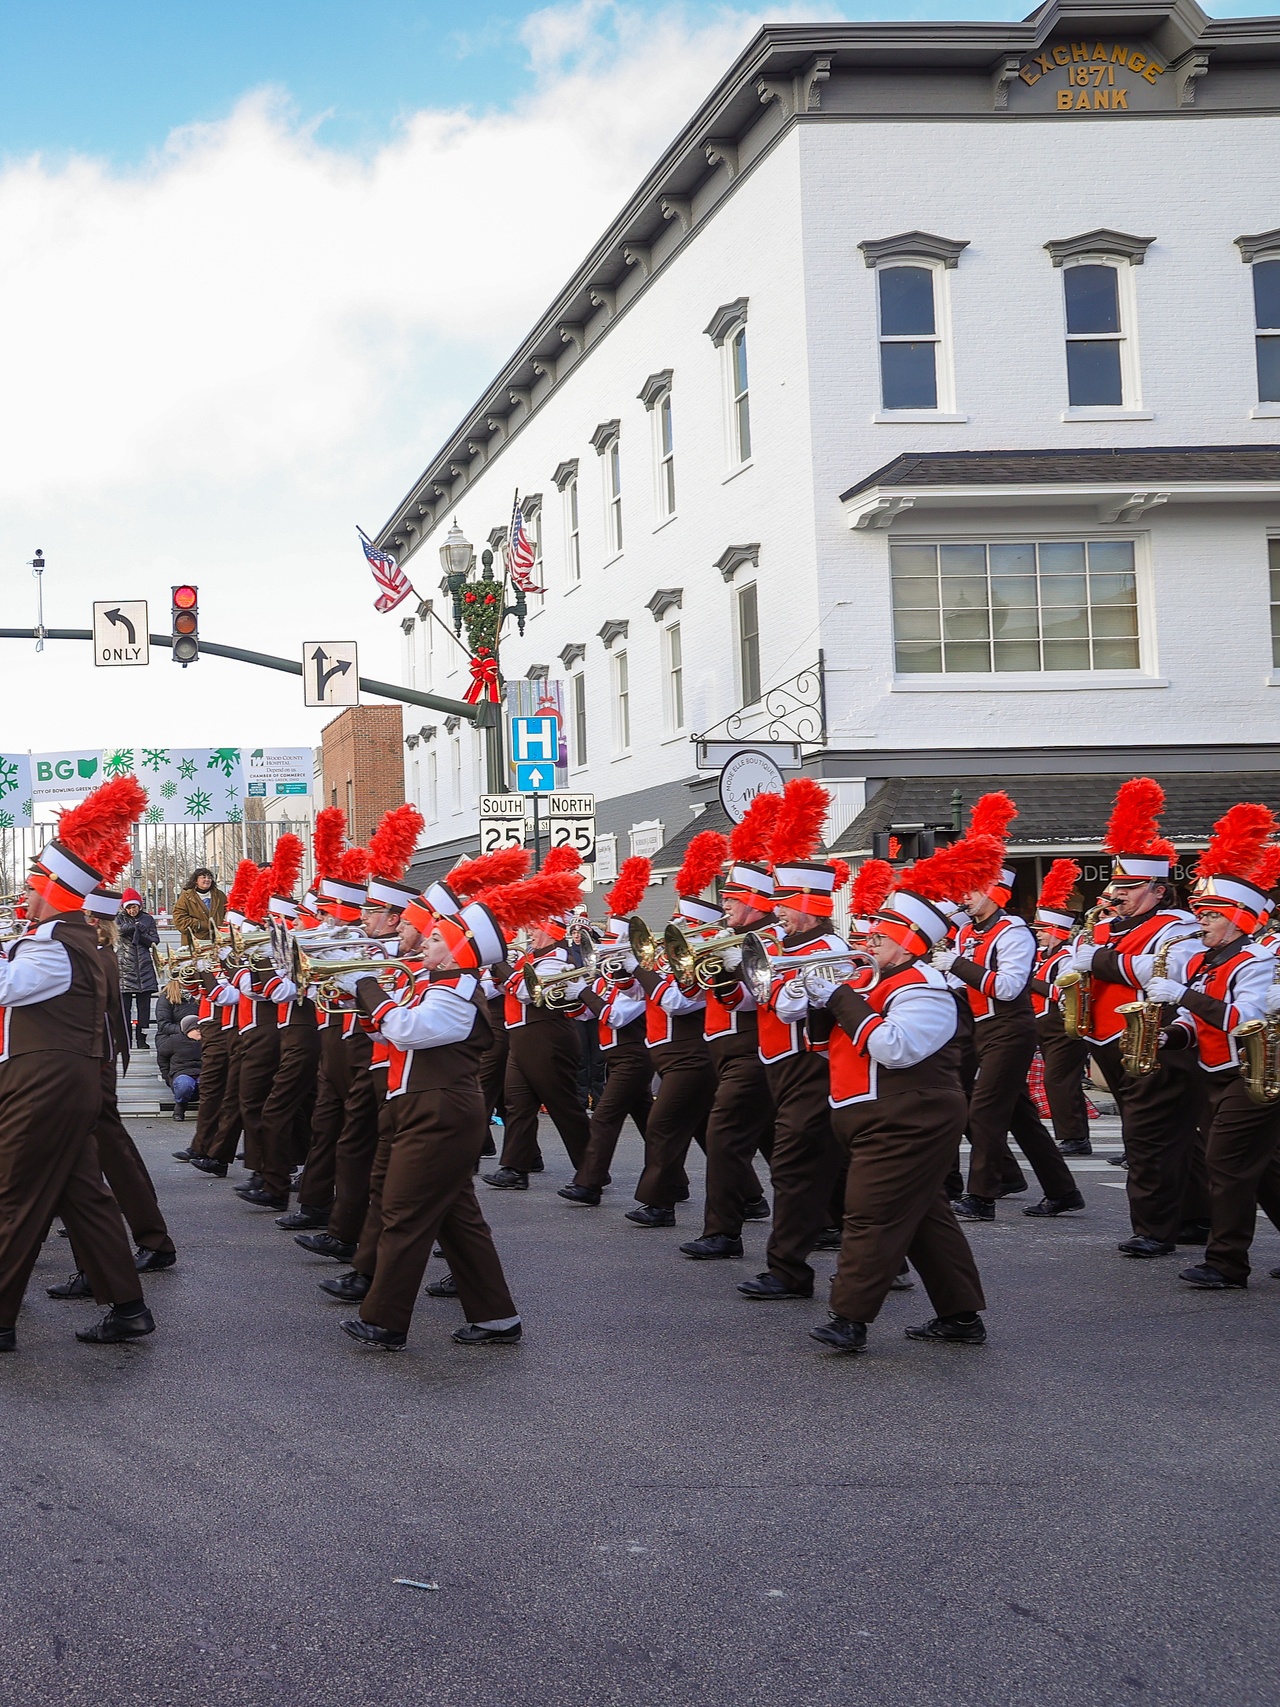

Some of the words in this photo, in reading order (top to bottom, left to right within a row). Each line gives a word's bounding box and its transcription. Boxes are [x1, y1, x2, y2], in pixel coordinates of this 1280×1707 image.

[1019, 40, 1165, 86] EXCHANGE
[1068, 65, 1115, 87] 1871
[1056, 89, 1129, 111] BANK
[102, 647, 141, 661] ONLY
[518, 719, 552, 759] H
[36, 760, 75, 781] BG
[726, 772, 735, 792] MODE
[733, 759, 745, 772] ELLE
[746, 757, 775, 776] BOUTIQUE
[482, 798, 522, 813] SOUTH
[552, 799, 592, 812] NORTH
[485, 828, 521, 852] 25
[555, 827, 591, 851] 25
